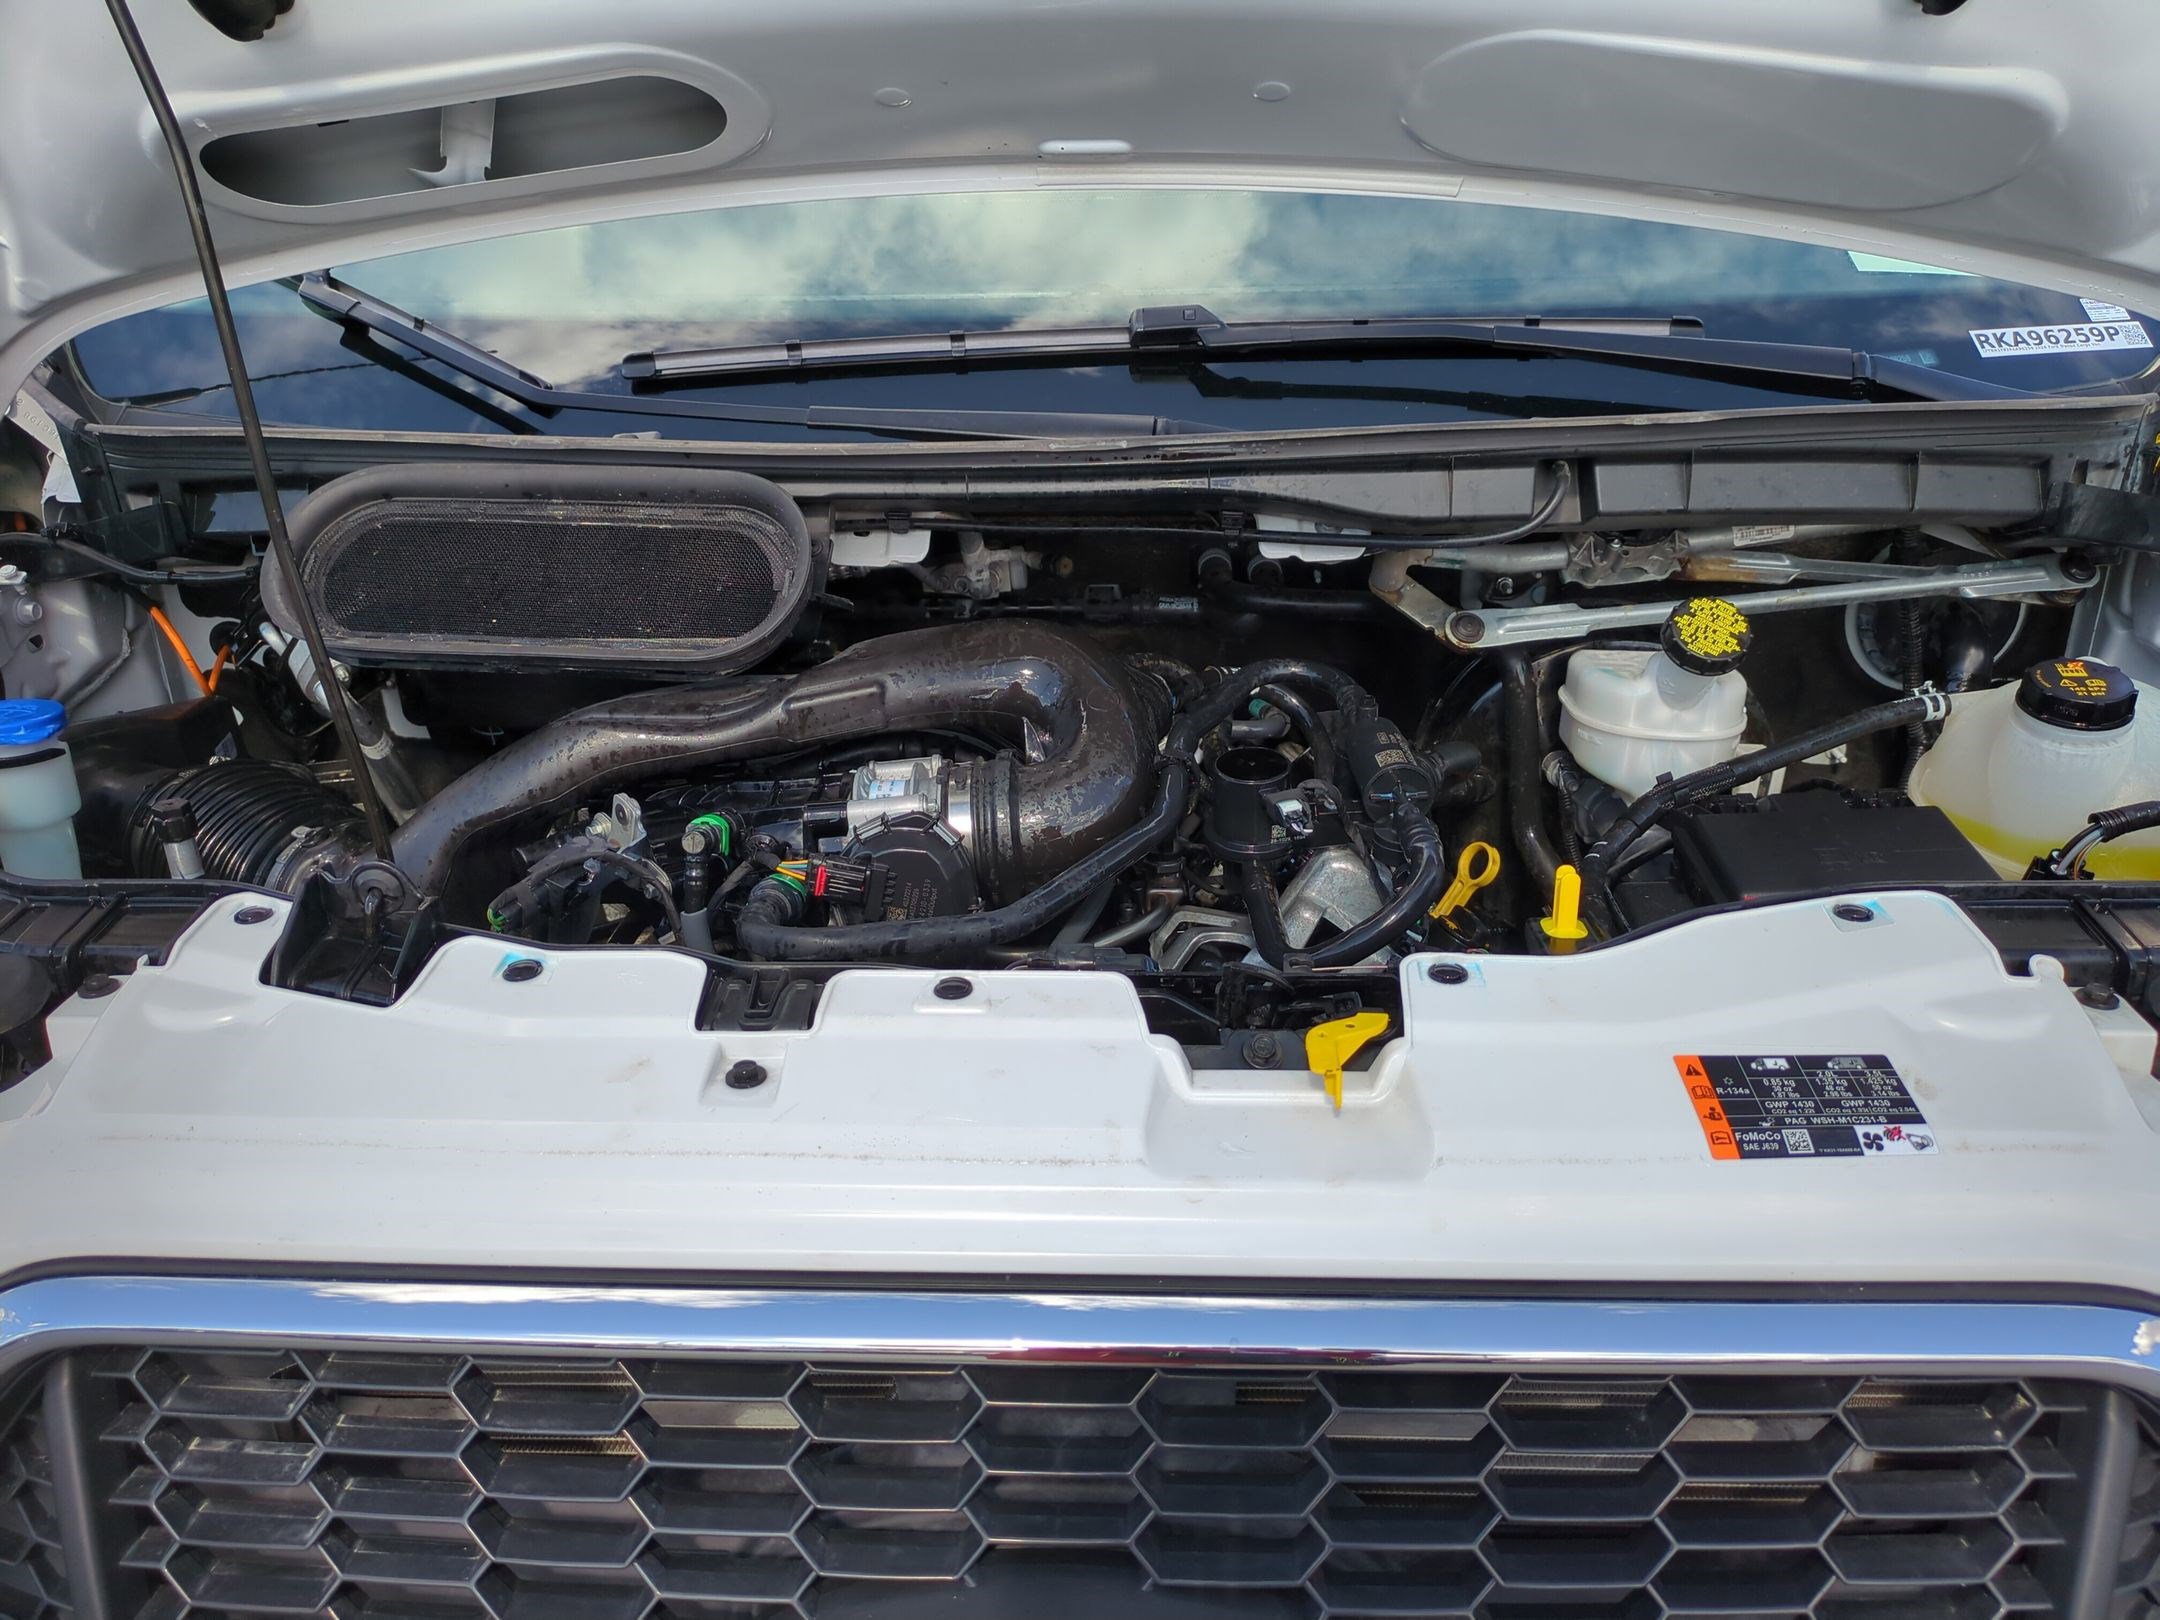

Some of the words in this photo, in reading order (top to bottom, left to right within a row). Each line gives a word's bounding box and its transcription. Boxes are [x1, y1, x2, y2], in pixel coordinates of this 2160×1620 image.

[1974, 326, 2120, 350] RKA96259P
[1783, 1078, 1796, 1087] kg
[1836, 1077, 1848, 1086] kg
[1884, 1077, 1897, 1086] kg
[1810, 1116, 1887, 1124] WSH-M1C231-B
[1735, 1131, 1781, 1141] FoMoCo
